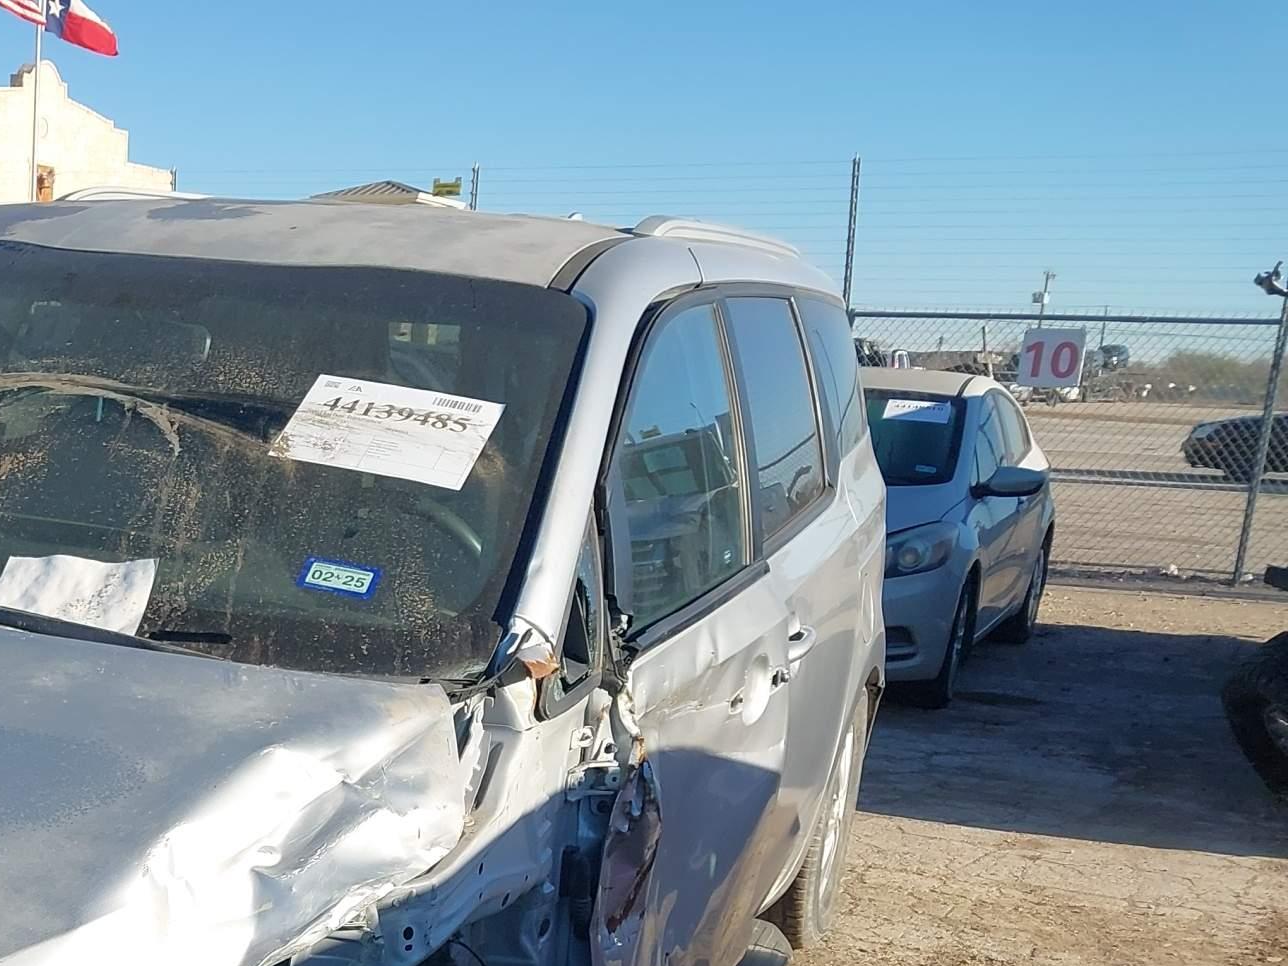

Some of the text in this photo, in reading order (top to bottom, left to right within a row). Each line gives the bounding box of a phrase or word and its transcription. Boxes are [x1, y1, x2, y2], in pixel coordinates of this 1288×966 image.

[1025, 341, 1079, 379] 10
[316, 396, 472, 433] 44139485
[311, 569, 334, 583] 02
[341, 575, 366, 589] 25
